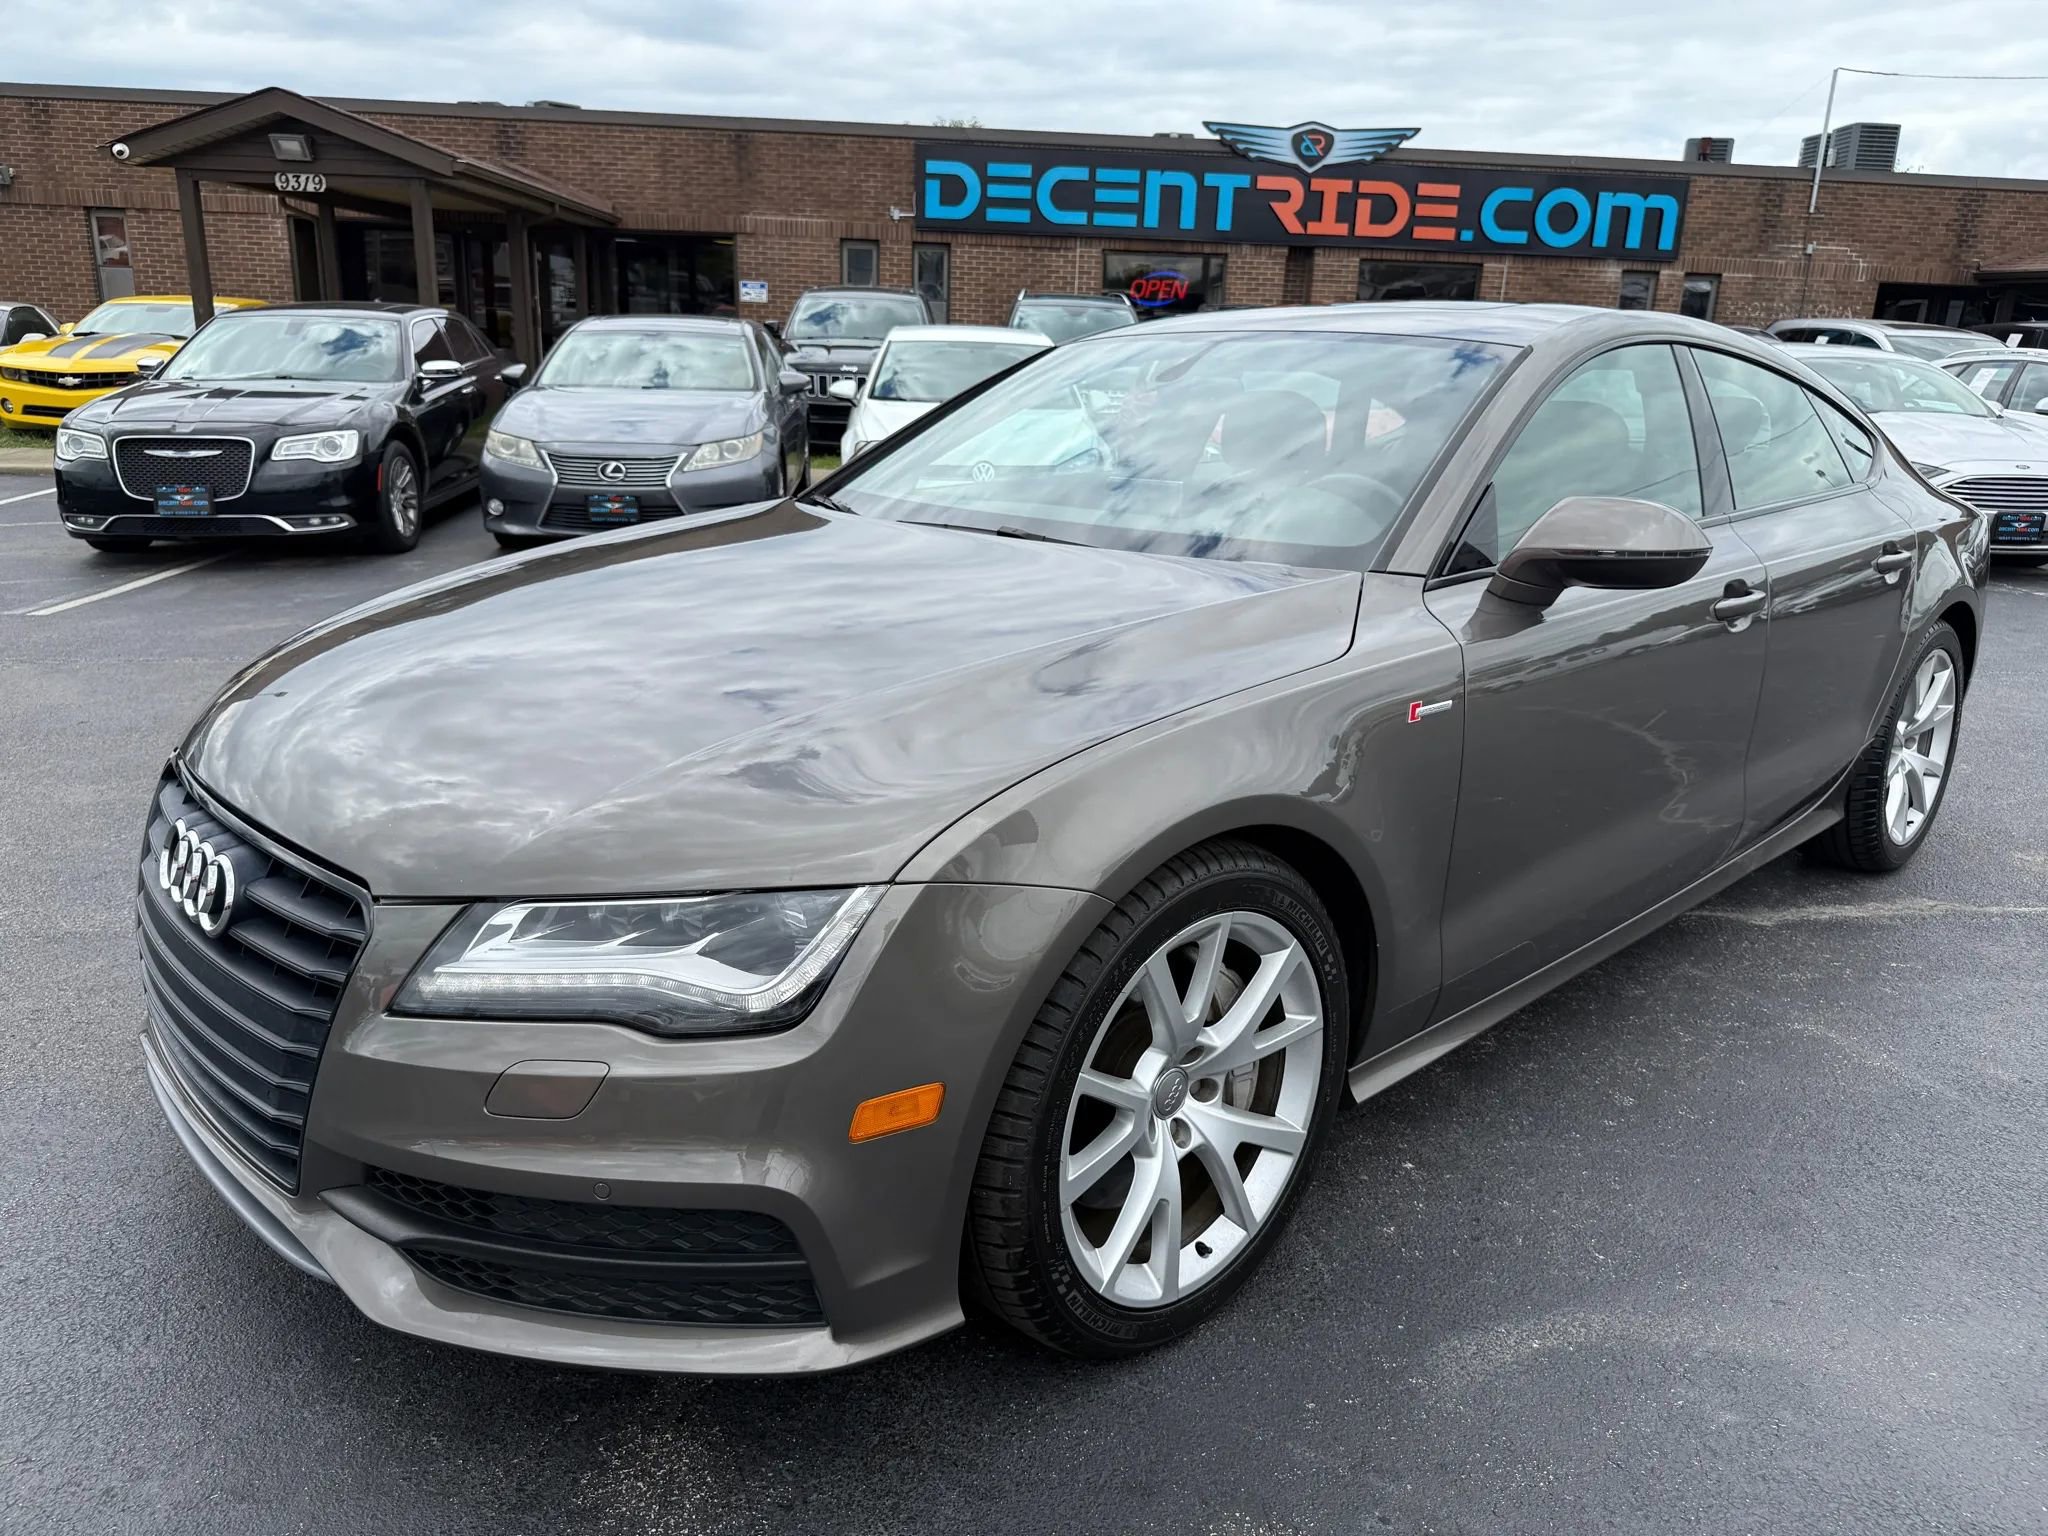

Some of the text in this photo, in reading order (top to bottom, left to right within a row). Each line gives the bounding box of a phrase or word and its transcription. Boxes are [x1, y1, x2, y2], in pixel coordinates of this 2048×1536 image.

[279, 173, 323, 191] 9319
[1129, 279, 1189, 299] OPEN
[1286, 899, 1329, 957] MICHELIN
